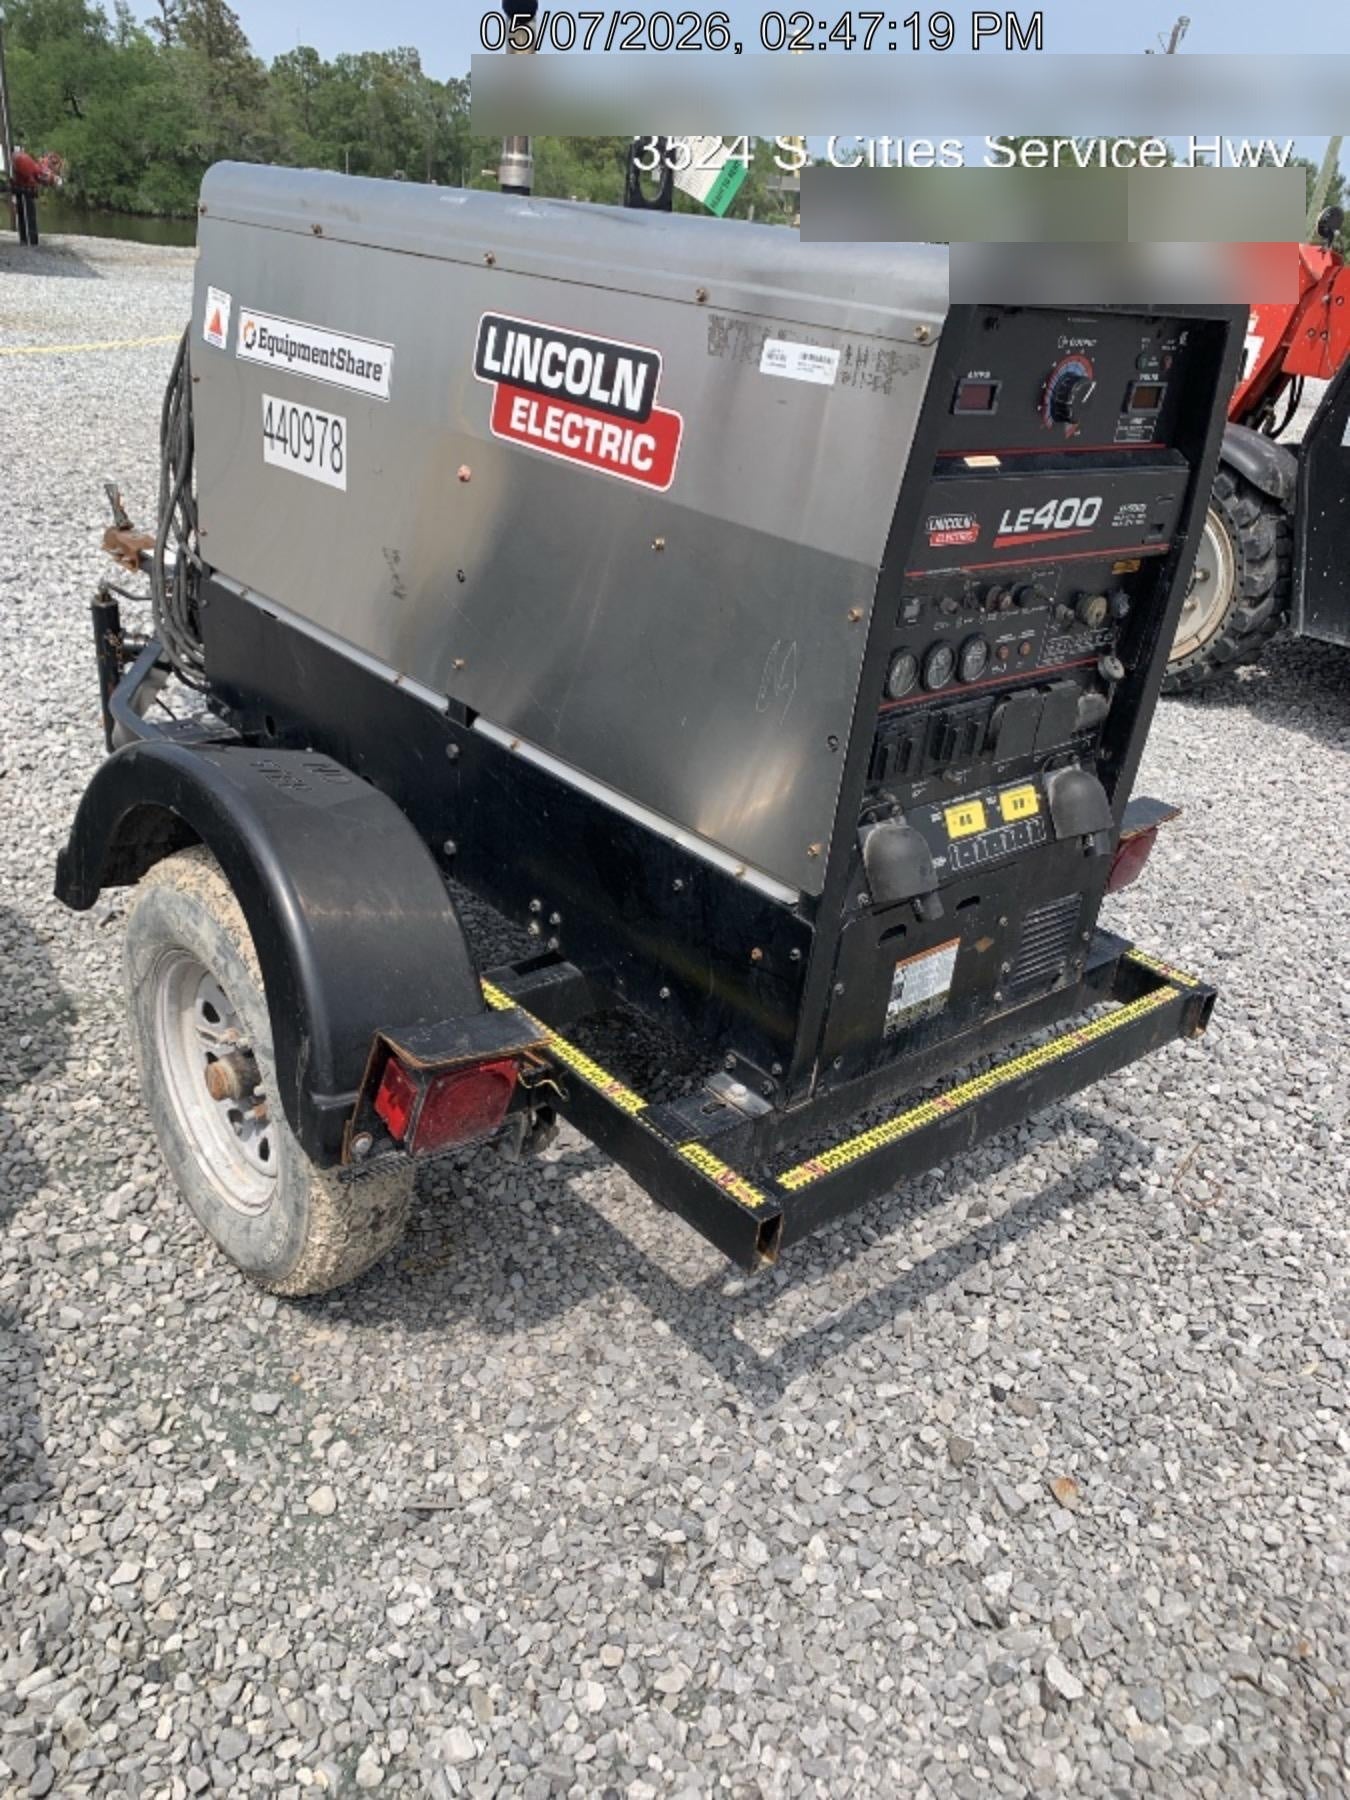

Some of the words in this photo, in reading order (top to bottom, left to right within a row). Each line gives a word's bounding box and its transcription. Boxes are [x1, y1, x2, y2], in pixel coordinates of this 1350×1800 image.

[258, 327, 384, 382] EquipmentShare
[483, 325, 649, 413] LINCOLN
[263, 401, 343, 474] 440978
[509, 396, 656, 472] ELECTRIC
[998, 497, 1103, 534] LE400
